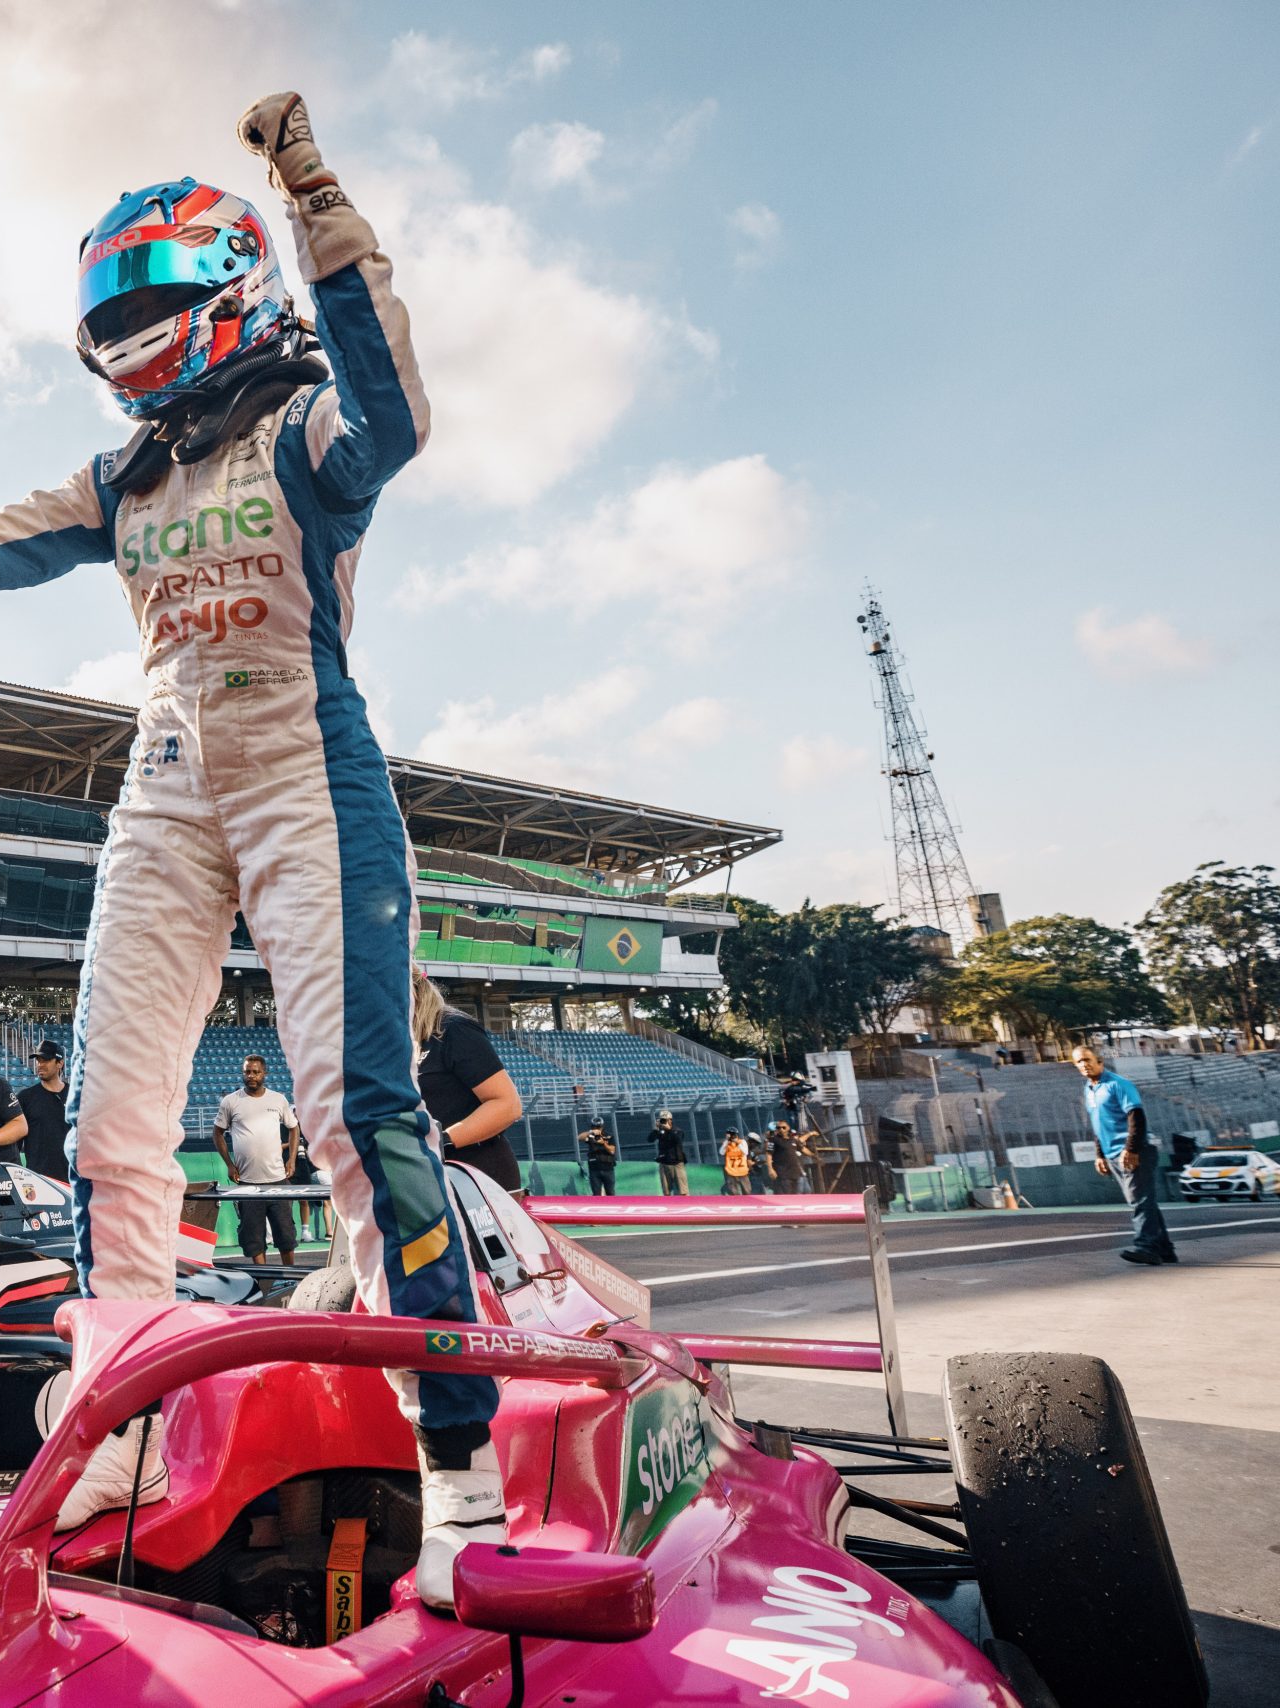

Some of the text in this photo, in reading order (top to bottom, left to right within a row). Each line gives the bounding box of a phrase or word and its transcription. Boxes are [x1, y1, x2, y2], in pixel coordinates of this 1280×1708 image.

[122, 497, 274, 577] stone
[153, 596, 269, 644] ANJO
[234, 632, 269, 641] TINTAS
[249, 668, 305, 677] RAFAELA
[249, 675, 309, 686] FERREIRA
[729, 1157, 745, 1169] 72
[50, 1210, 63, 1220] Red
[467, 1204, 494, 1230] TMG
[637, 1406, 703, 1516] stone
[886, 1596, 910, 1621] TINTAS
[725, 1566, 905, 1700] ANJO
